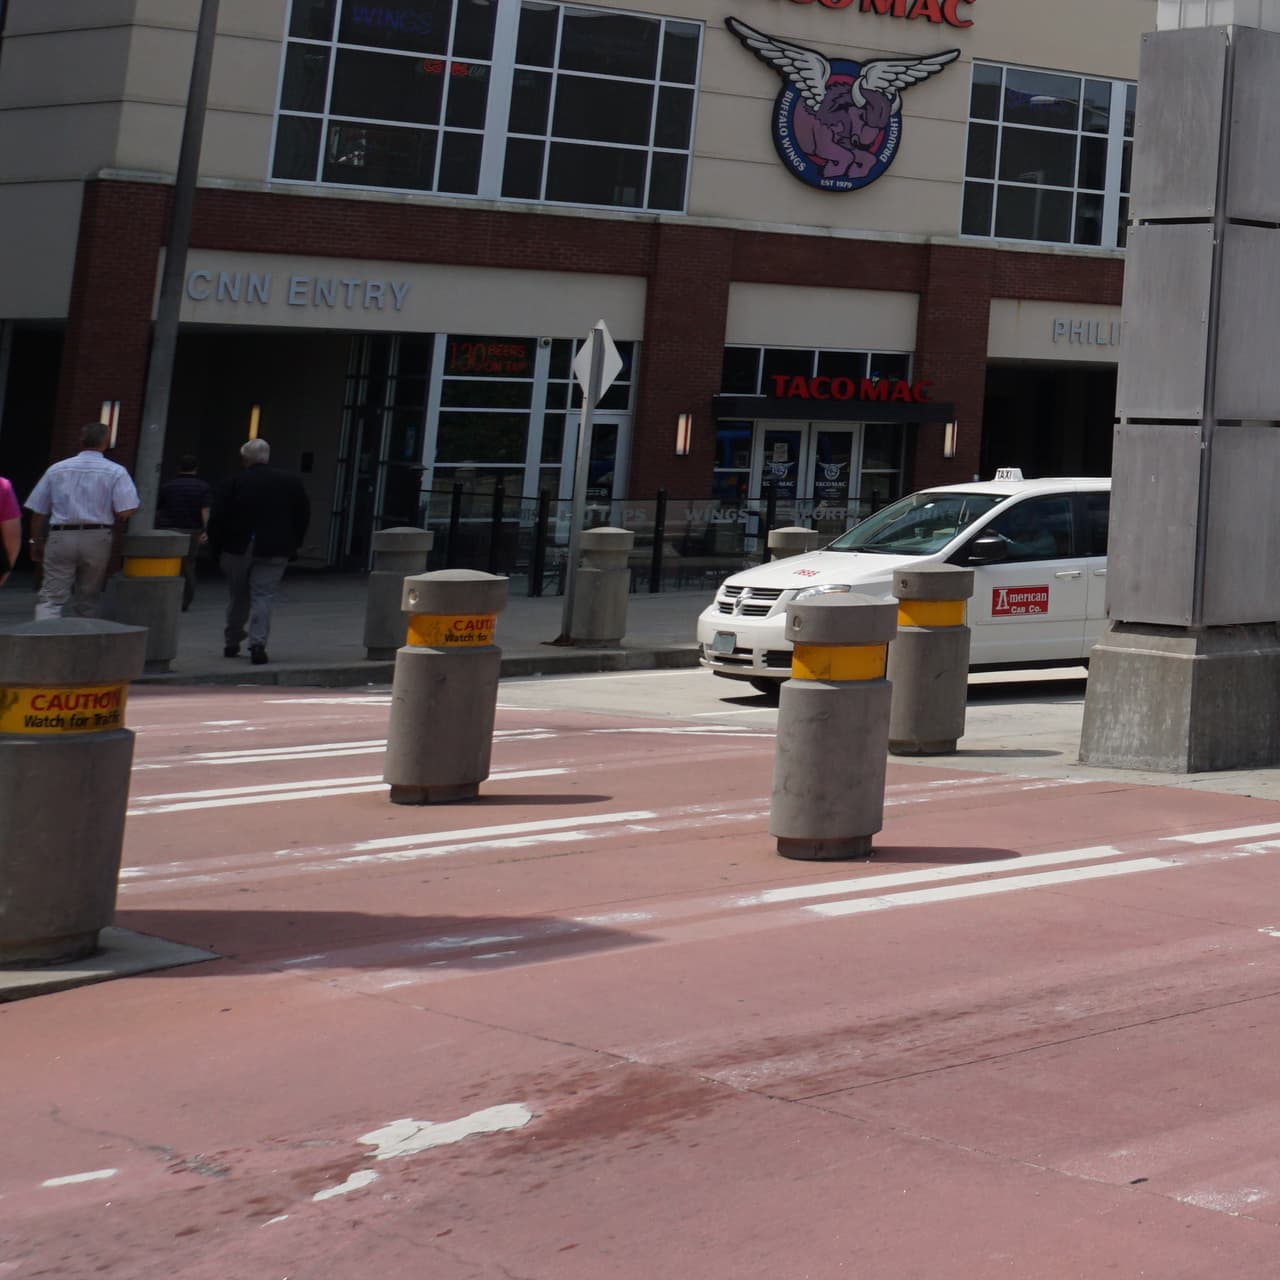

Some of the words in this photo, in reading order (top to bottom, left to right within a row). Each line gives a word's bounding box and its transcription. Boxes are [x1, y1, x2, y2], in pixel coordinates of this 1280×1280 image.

[352, 5, 433, 35] WINGS
[778, 90, 794, 136] BUFFALO
[879, 117, 899, 163] DRAUGHT
[781, 137, 807, 172] WINGS
[186, 270, 272, 305] CNN
[287, 275, 411, 311] ENTRY
[772, 375, 855, 401] TACO
[859, 378, 934, 403] MAC
[997, 470, 1012, 480] TAXI
[685, 507, 750, 522] WINGS
[995, 589, 1047, 610] American
[453, 618, 496, 632] CAUT
[24, 713, 65, 729] Watch
[70, 713, 90, 728] for
[94, 710, 121, 726] Traff
